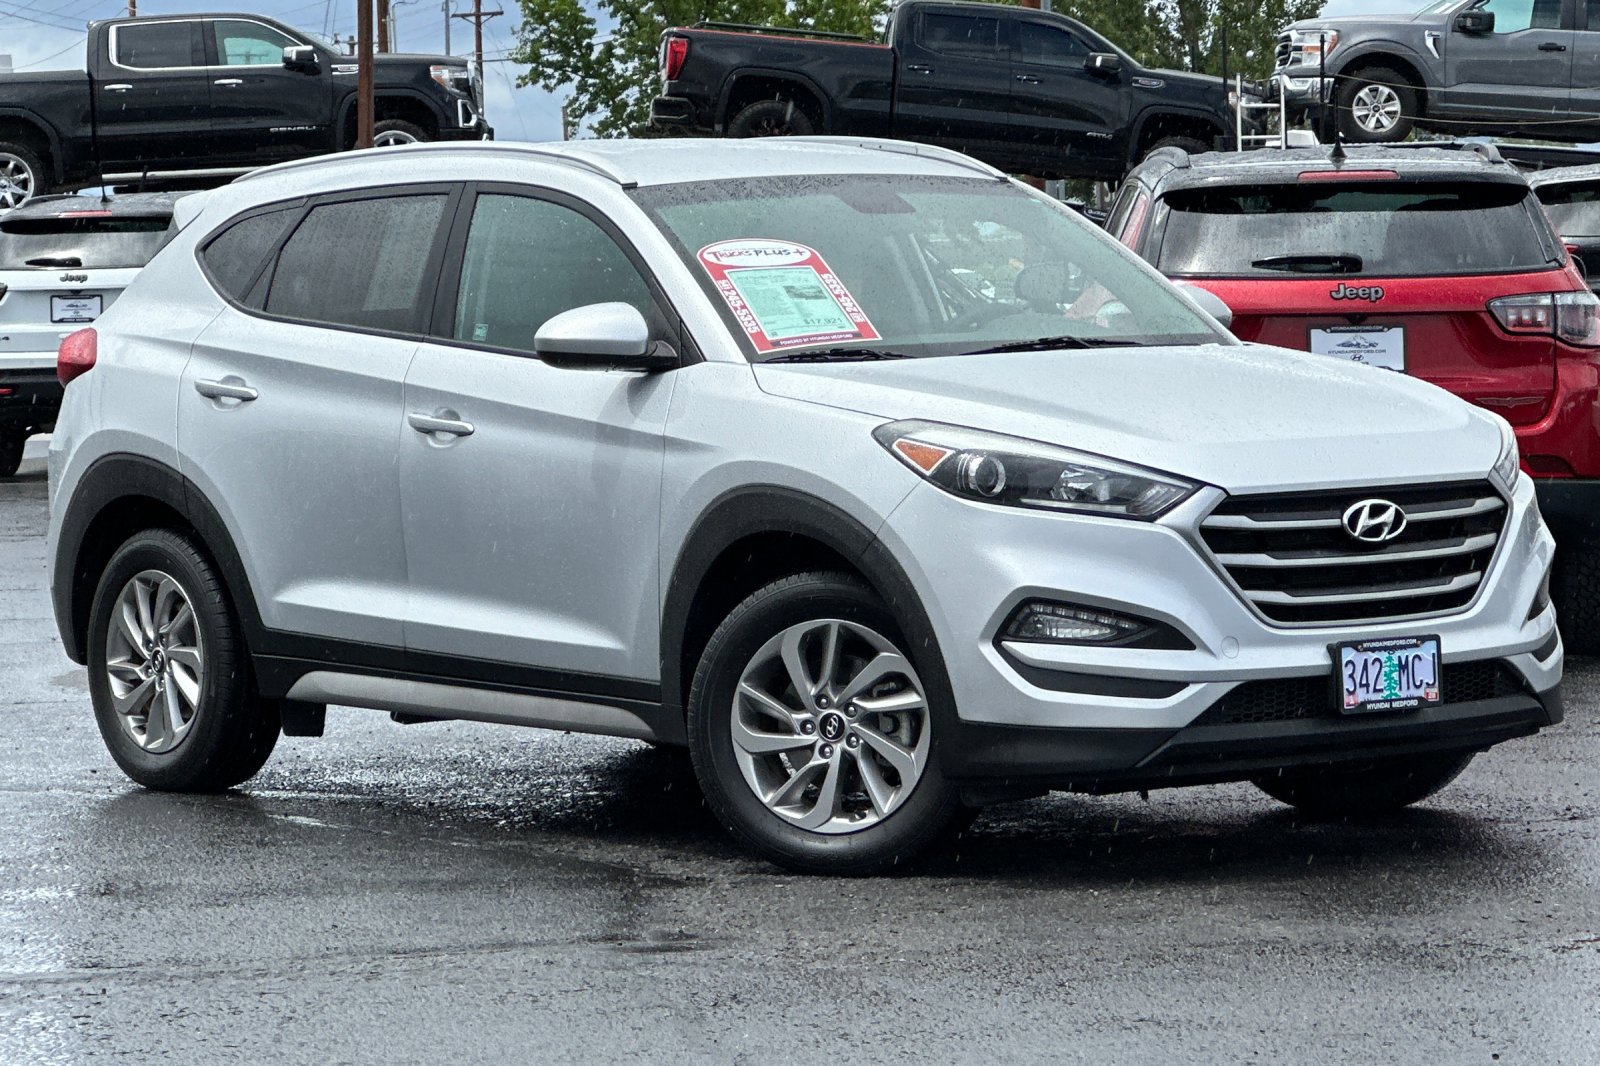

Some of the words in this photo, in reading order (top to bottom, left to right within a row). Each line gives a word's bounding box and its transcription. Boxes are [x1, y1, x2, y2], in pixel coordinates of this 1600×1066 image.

[59, 273, 88, 283] Jeep
[1330, 283, 1384, 303] Jeep
[722, 289, 761, 334] 245-5335
[1345, 657, 1383, 695] 342
[1398, 652, 1436, 690] MCJ
[1366, 702, 1391, 710] HYUNDAI
[1392, 699, 1419, 708] MEDFORD
